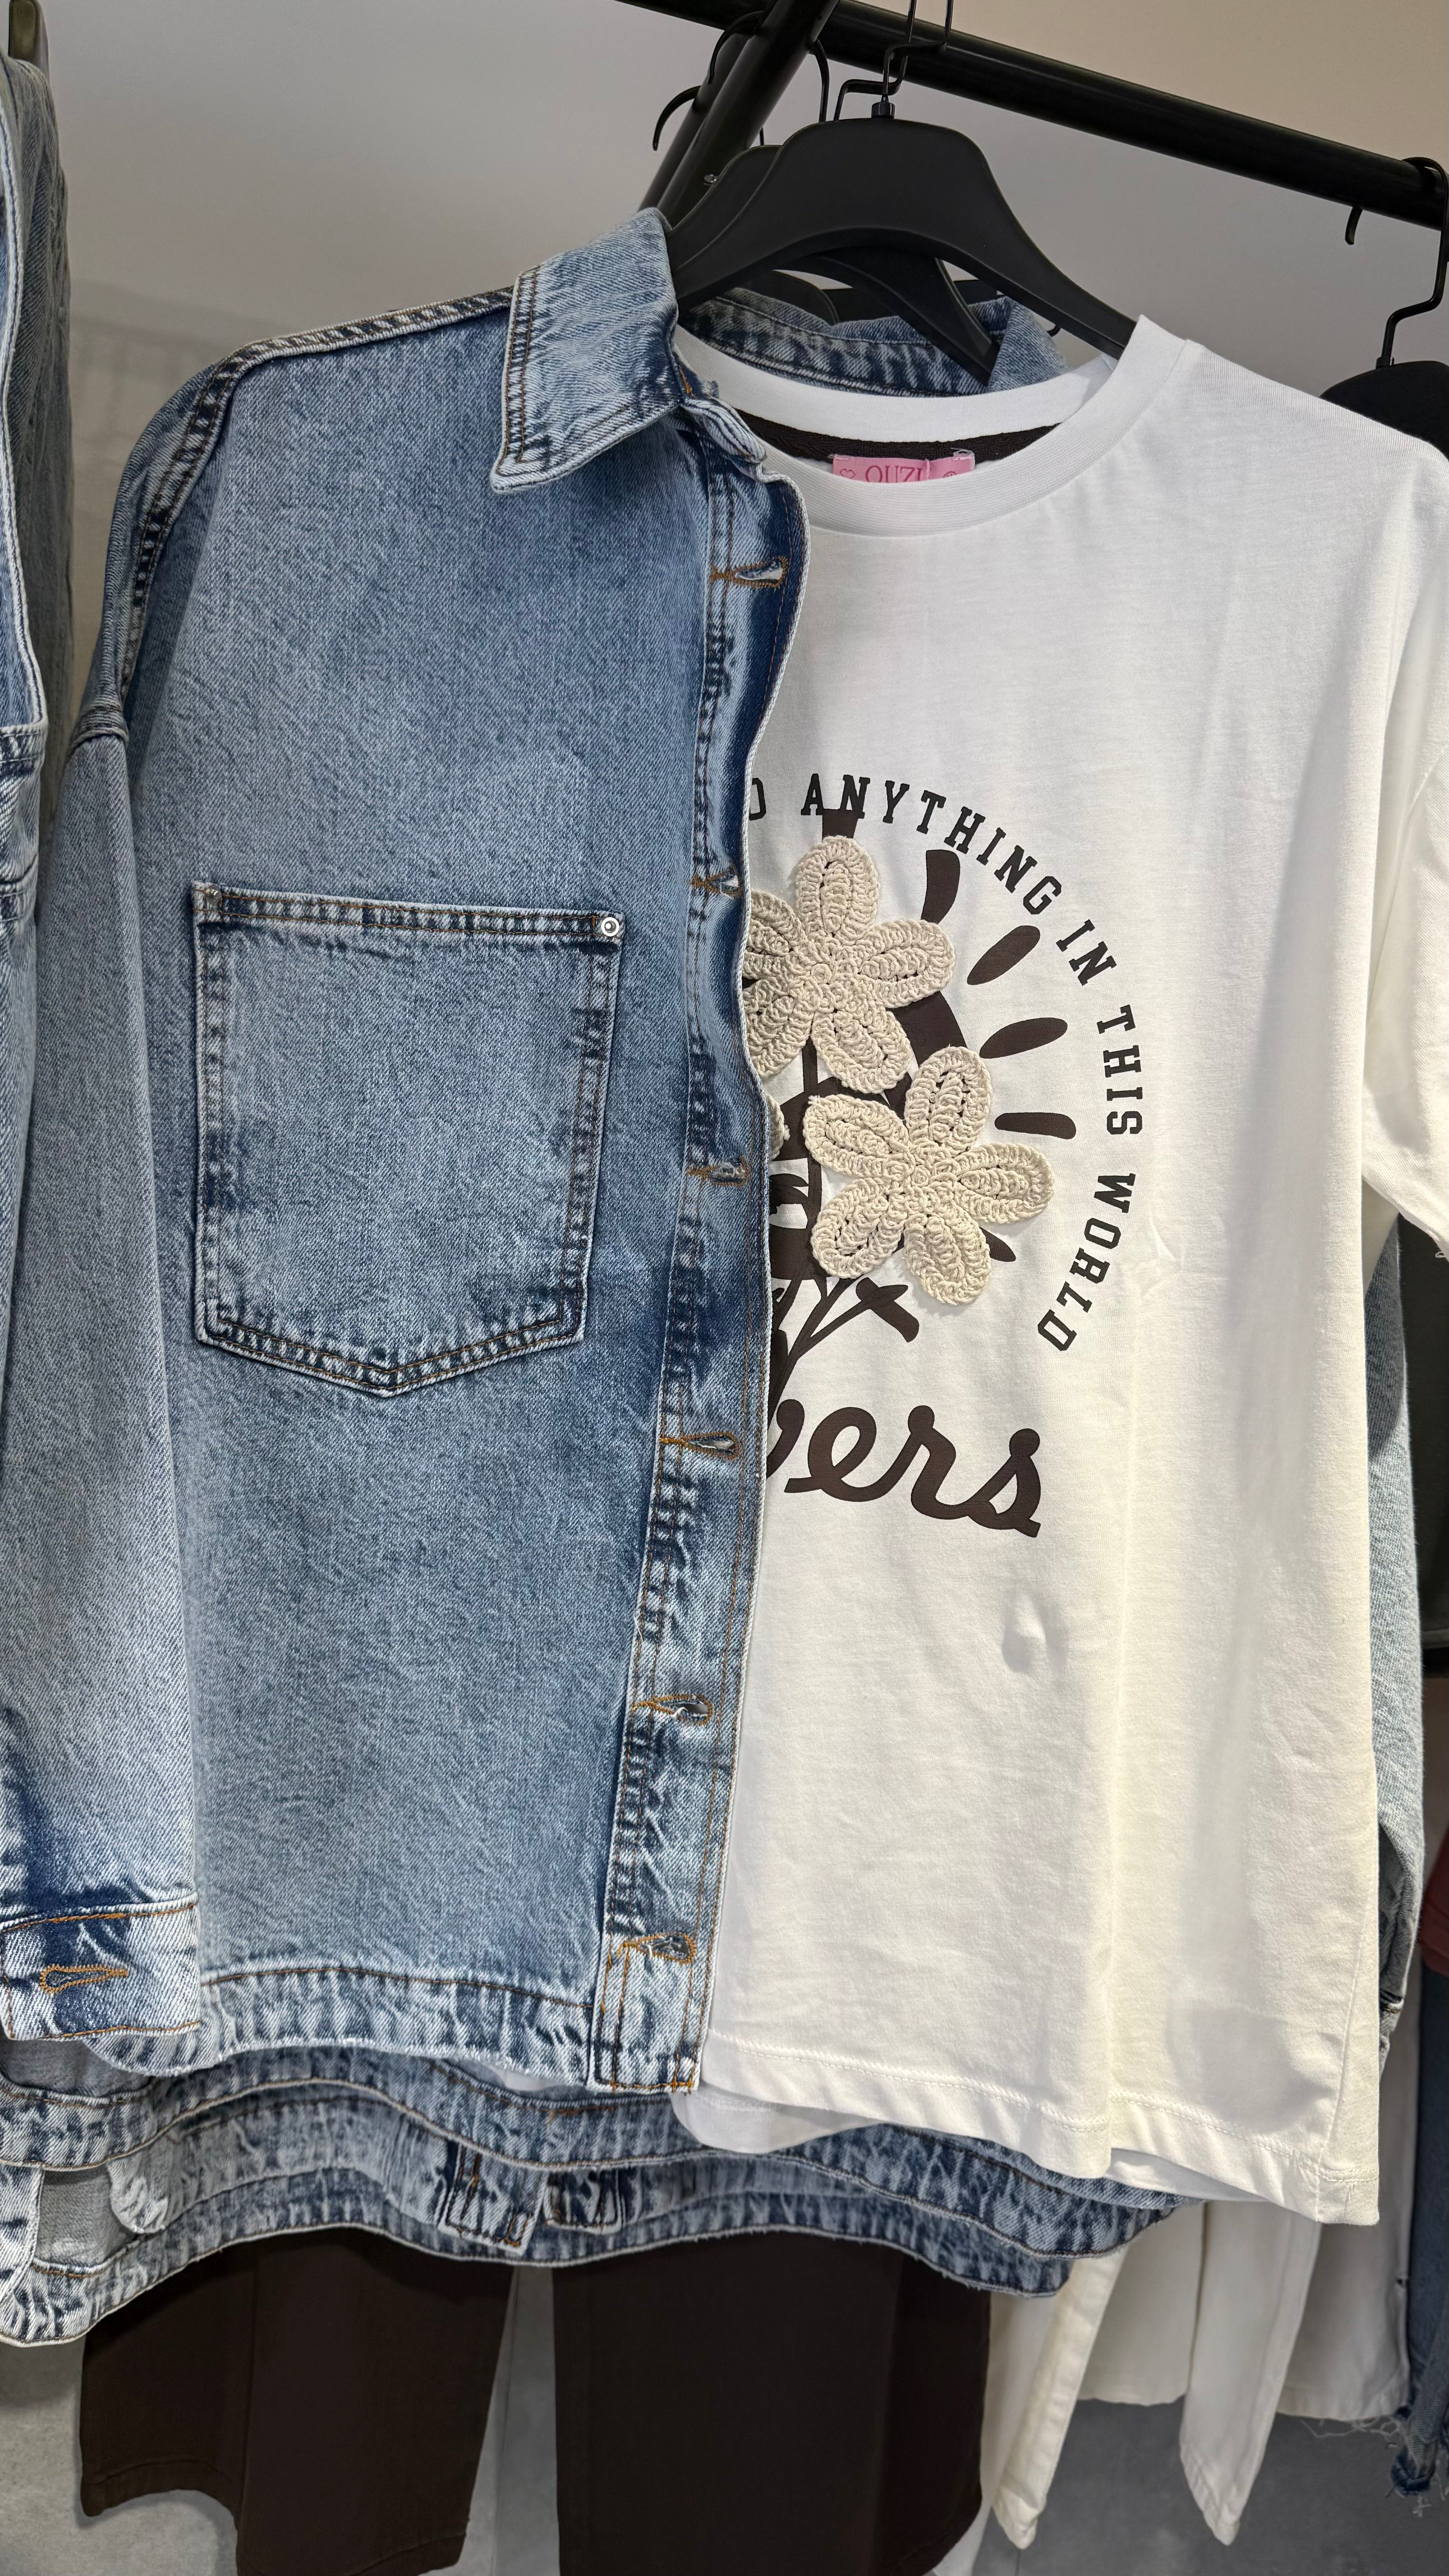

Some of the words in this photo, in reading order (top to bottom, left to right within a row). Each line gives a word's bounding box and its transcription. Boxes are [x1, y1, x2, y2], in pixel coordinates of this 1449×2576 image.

[800, 773, 1062, 915] ANYTHING
[1056, 919, 1117, 986] IN
[1096, 1004, 1143, 1135] THIS
[1037, 1173, 1136, 1351] WORLD
